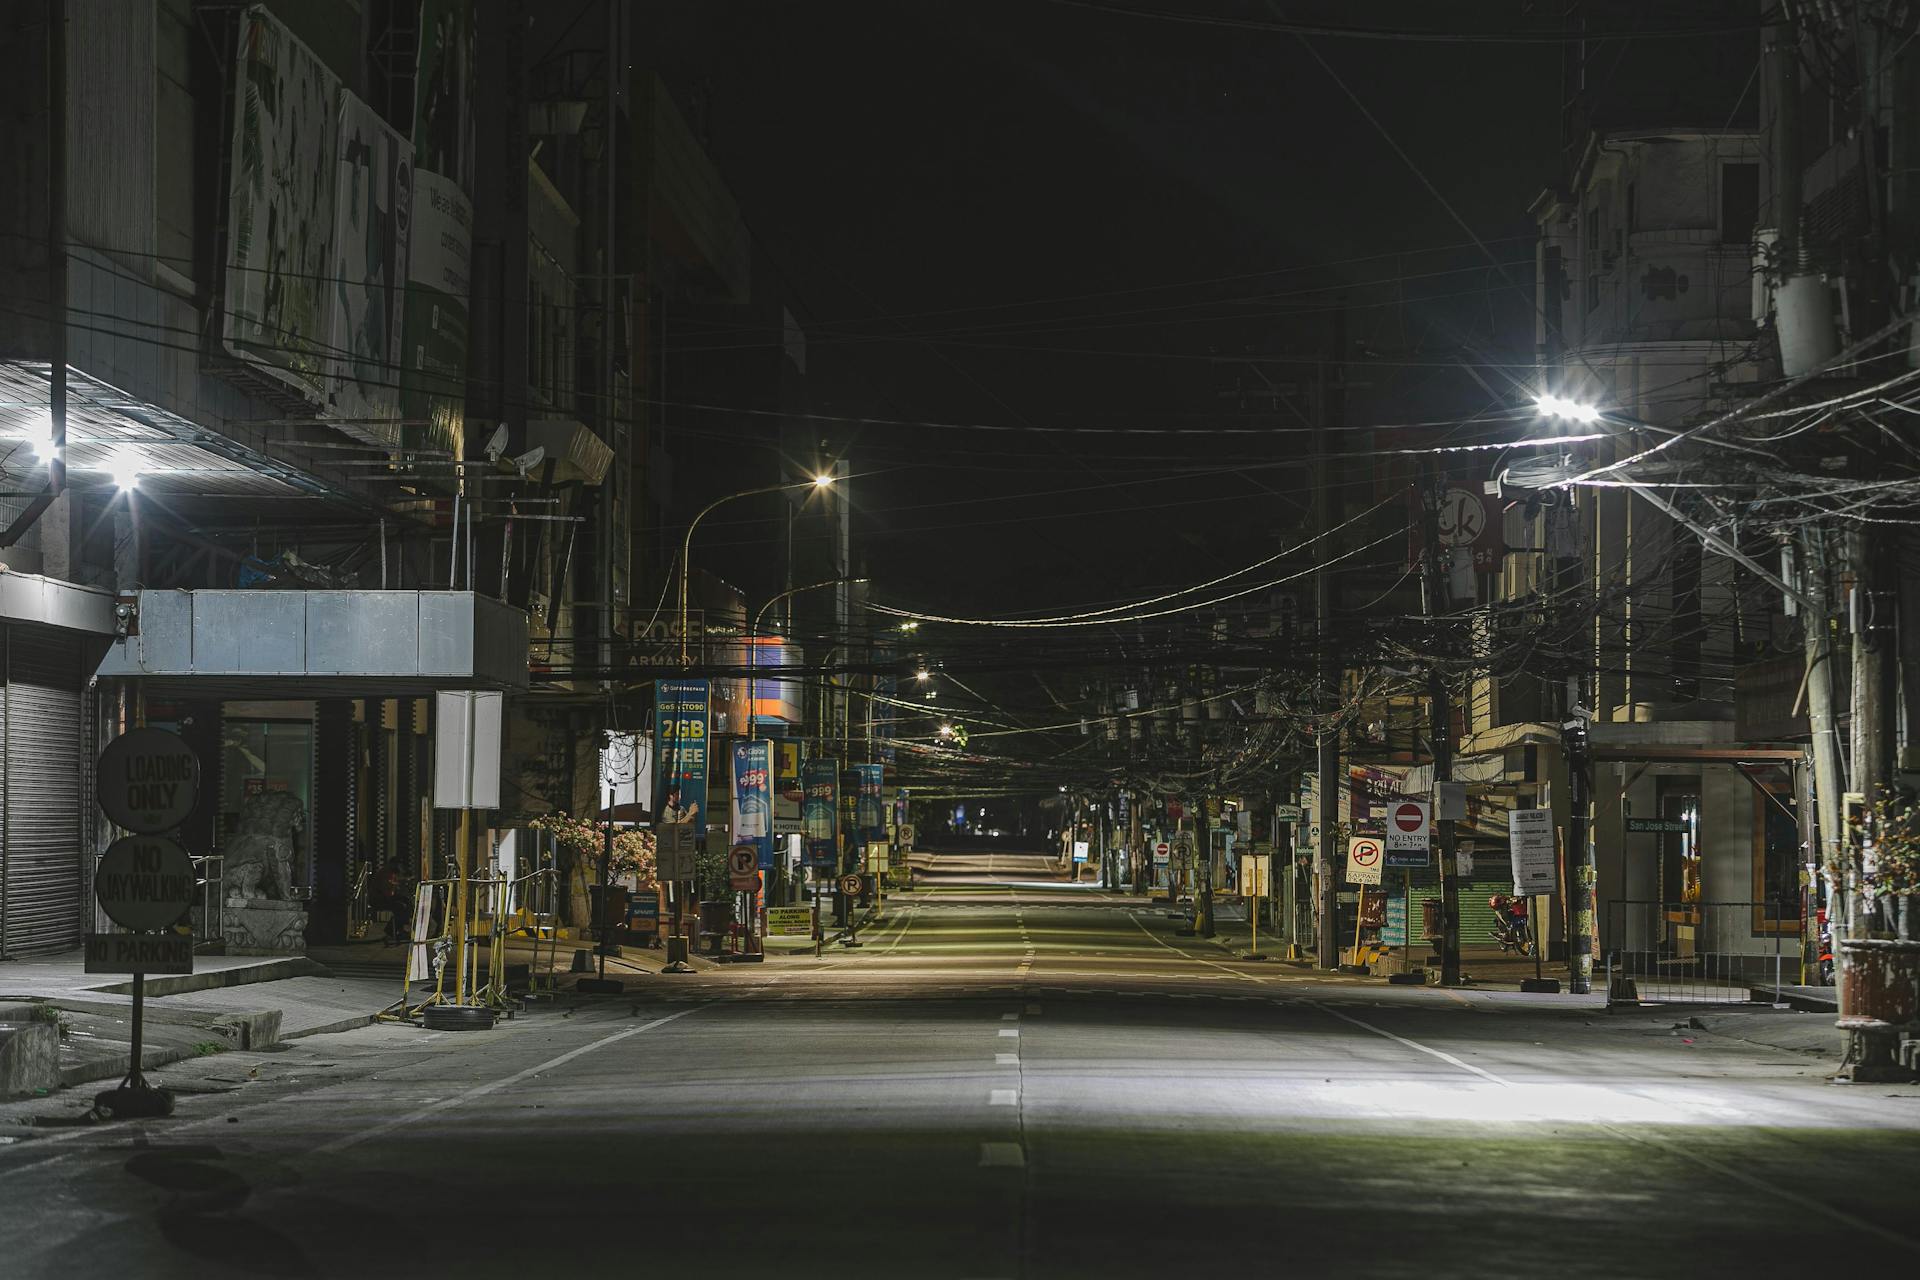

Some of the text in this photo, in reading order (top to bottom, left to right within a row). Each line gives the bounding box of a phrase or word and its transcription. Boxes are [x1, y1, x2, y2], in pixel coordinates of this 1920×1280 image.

[662, 719, 704, 738] 2GB
[126, 754, 192, 782] LOADING
[128, 784, 179, 810] ONLY
[1630, 821, 1687, 831] San Jose Street
[133, 845, 162, 872] NO
[103, 875, 192, 903] JAYWALKING
[88, 941, 190, 962] NO PARKING
